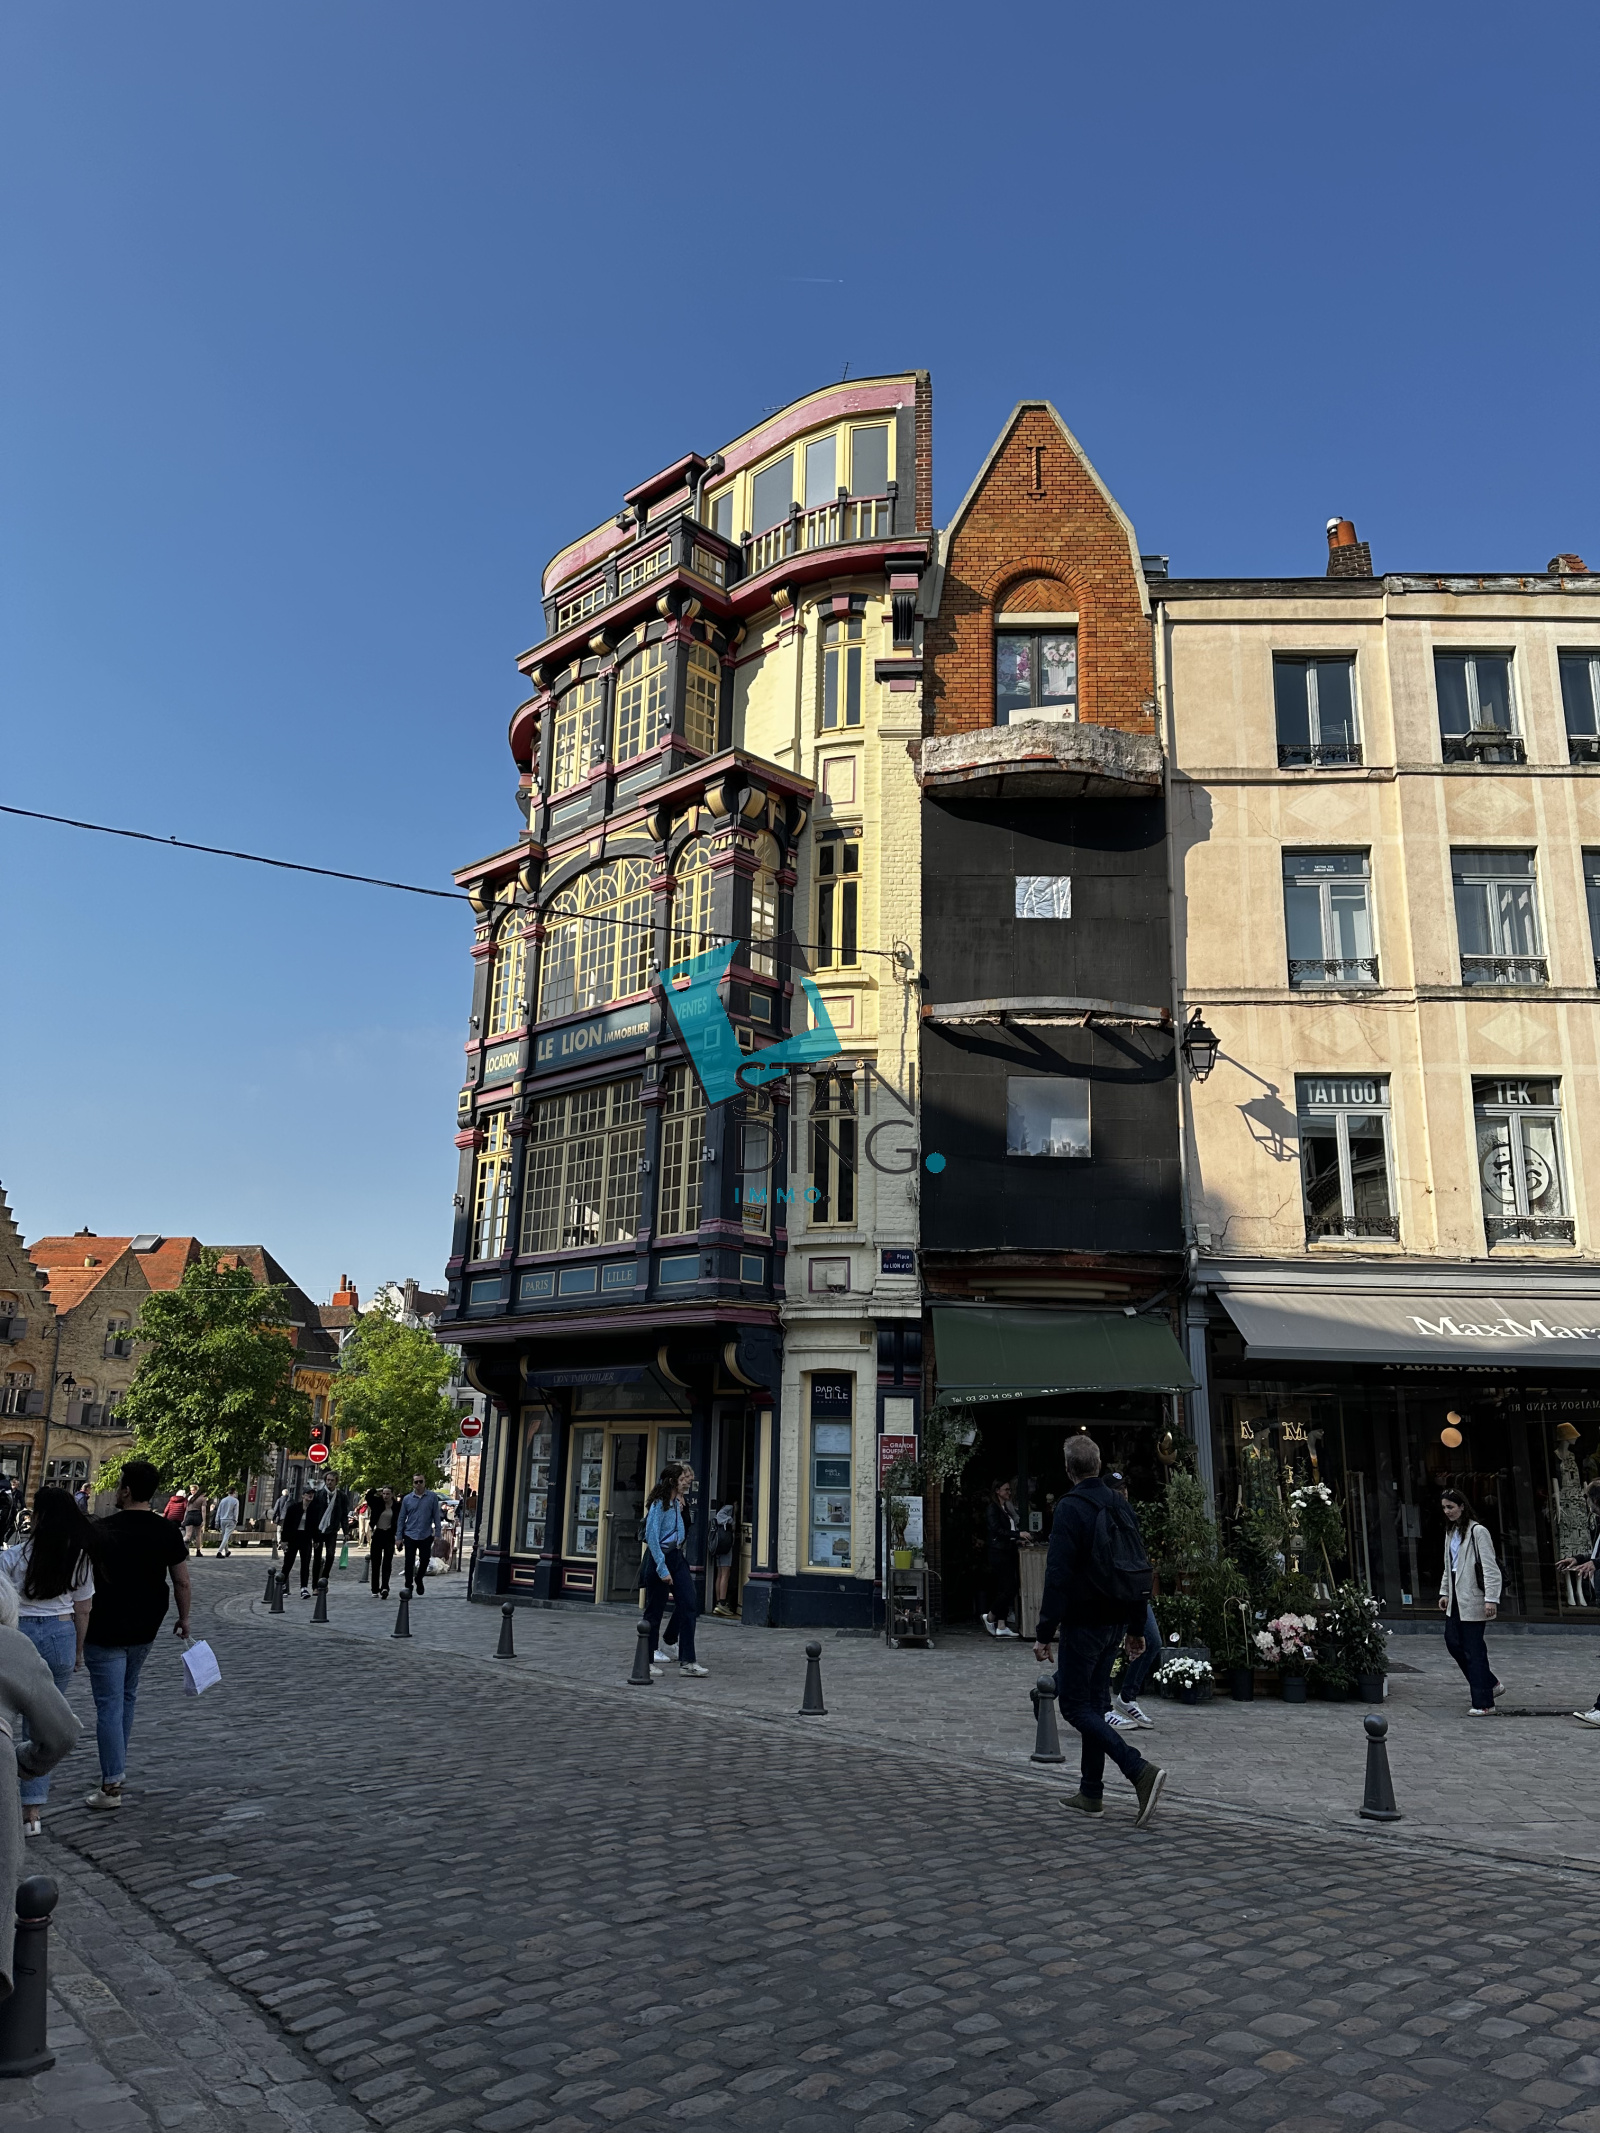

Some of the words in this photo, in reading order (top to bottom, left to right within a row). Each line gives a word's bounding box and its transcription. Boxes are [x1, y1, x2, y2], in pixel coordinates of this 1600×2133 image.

[675, 997, 708, 1021] VENTES
[537, 1038, 554, 1062] LE
[561, 1024, 603, 1056] LION
[604, 1021, 649, 1043] IMMOBILIER
[485, 1050, 519, 1074] LOCATION
[1303, 1080, 1377, 1104] TATTOO
[1493, 1081, 1532, 1104] TEK
[607, 1269, 633, 1283] LILLE
[525, 1279, 549, 1292] PARIS
[553, 1374, 568, 1384] LION
[570, 1371, 615, 1383] IMMOBILIER
[815, 1385, 841, 1394] PARIS
[825, 1392, 849, 1400] LILLE
